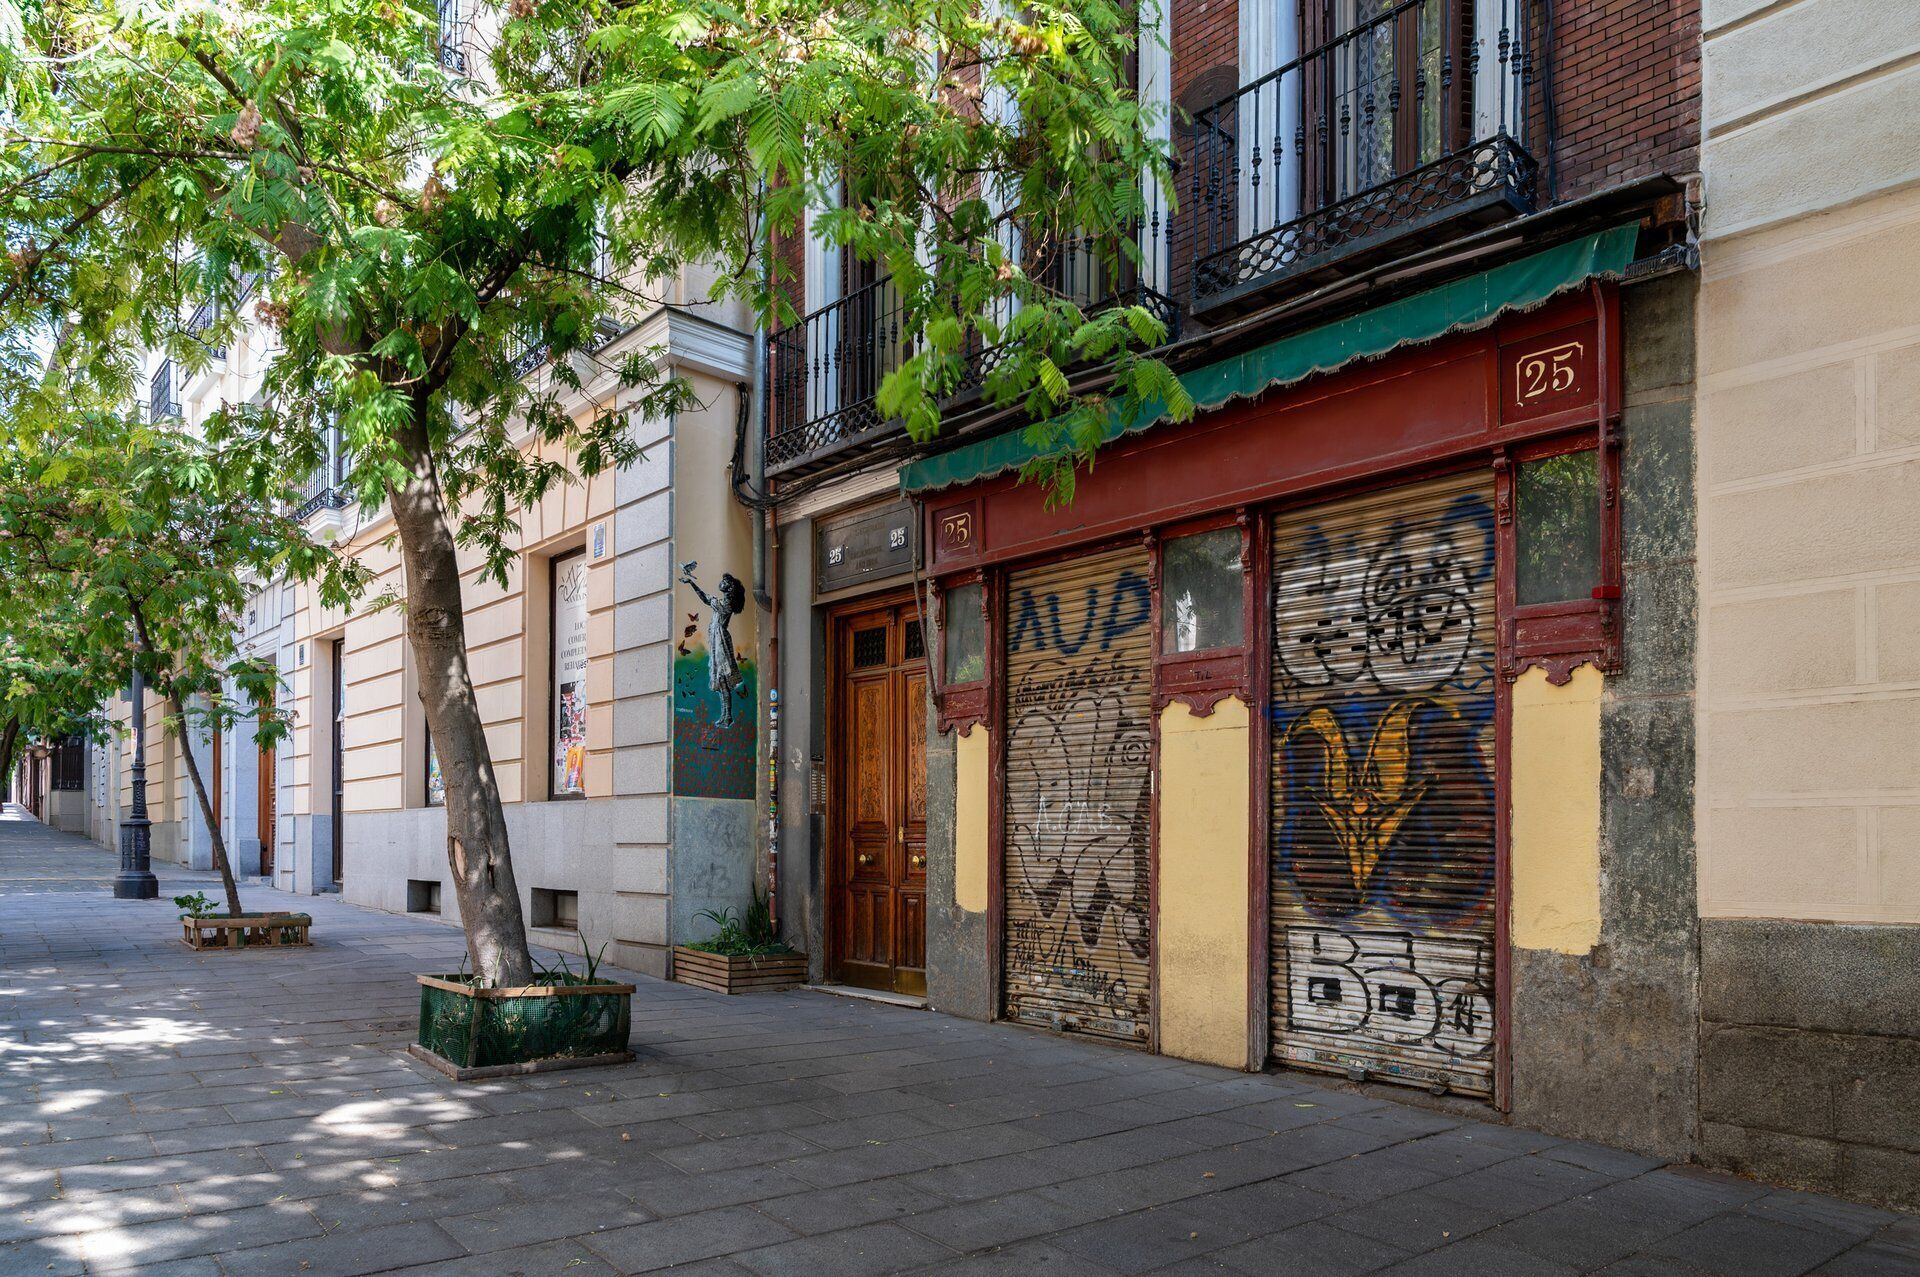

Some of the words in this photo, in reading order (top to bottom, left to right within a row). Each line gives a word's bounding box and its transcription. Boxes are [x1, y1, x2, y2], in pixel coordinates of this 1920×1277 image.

[1524, 350, 1575, 399] 25
[890, 528, 905, 548] 25
[944, 517, 968, 544] 25
[829, 548, 842, 565] 25
